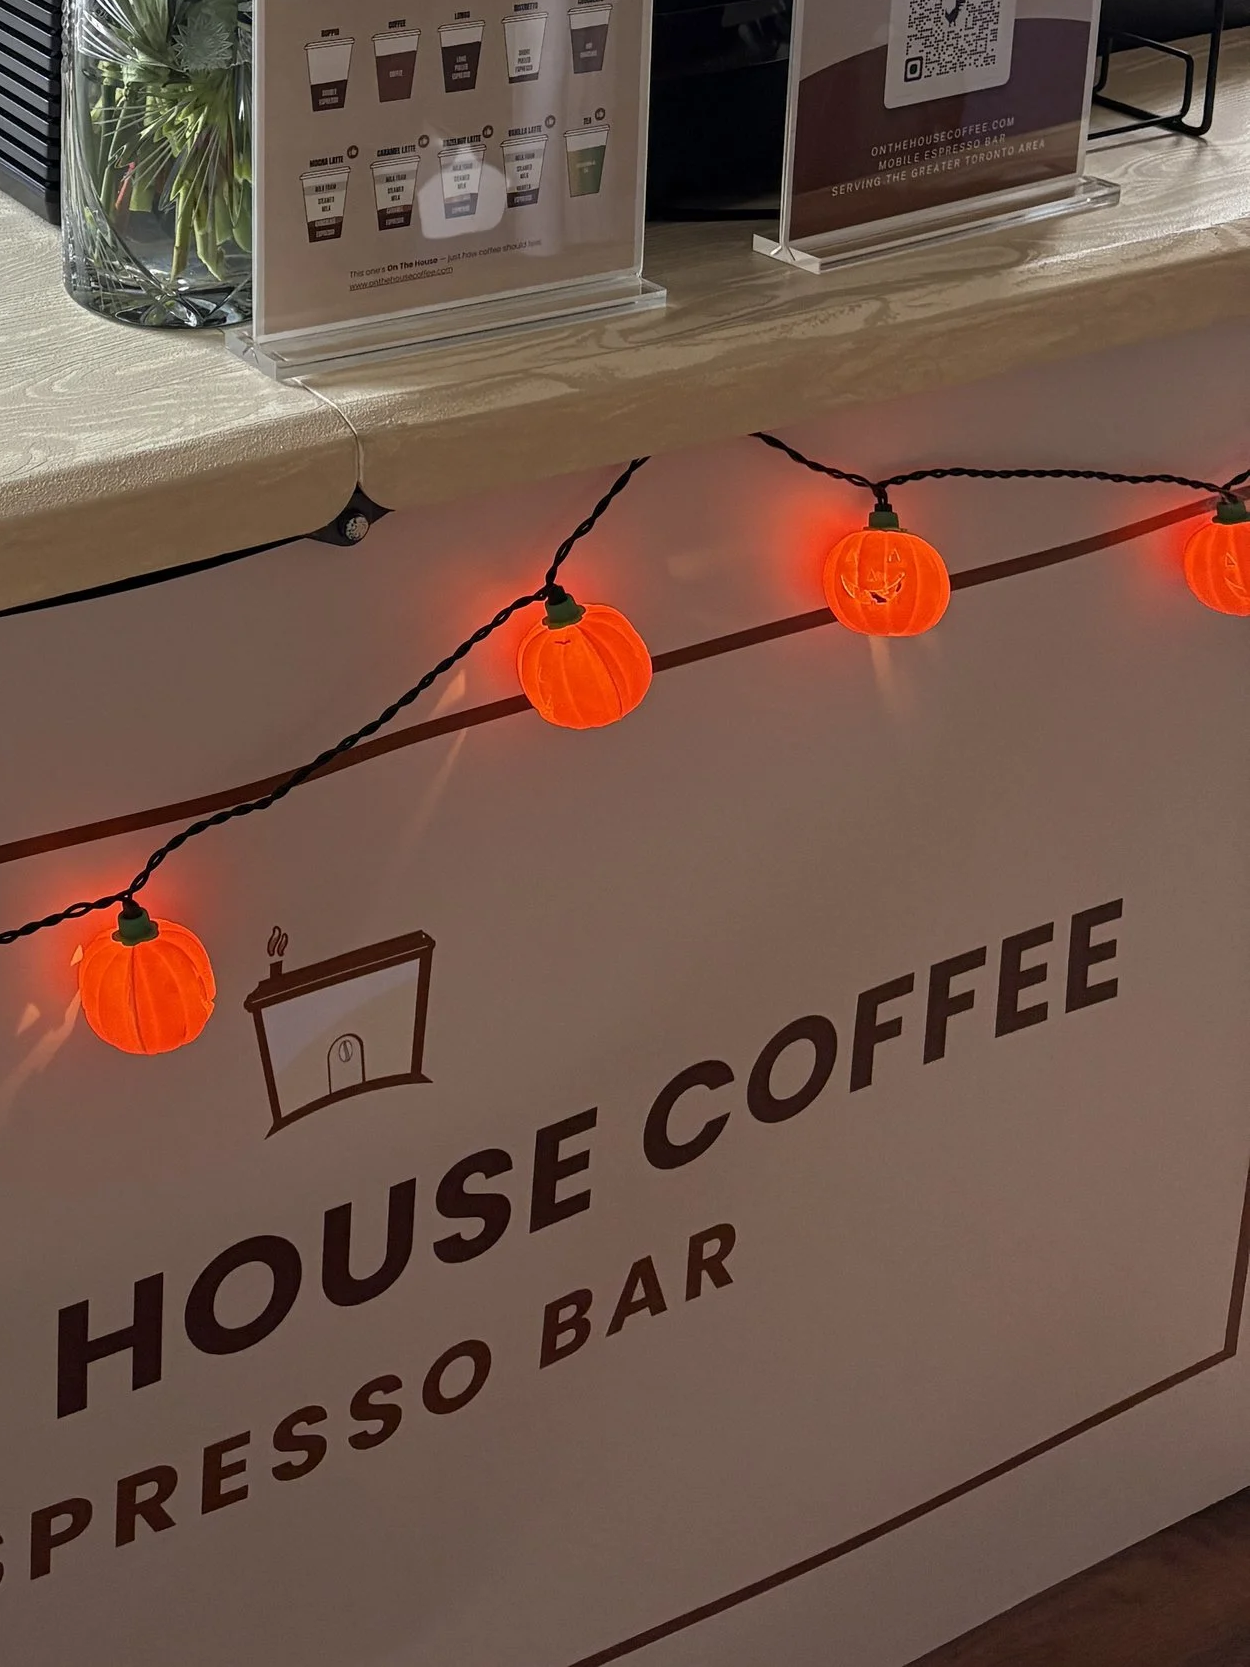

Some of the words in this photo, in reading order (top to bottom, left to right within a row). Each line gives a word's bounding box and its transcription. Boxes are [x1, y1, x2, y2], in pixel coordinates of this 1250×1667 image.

[871, 116, 1015, 157] ONTHEHOUSECOFFEE.COM
[878, 152, 920, 171] MOBILE
[924, 139, 981, 161] ESPRESSO
[984, 133, 1006, 147] BAR
[329, 155, 344, 165] LATTE
[831, 176, 881, 197] SERVING
[886, 170, 907, 183] THE
[911, 158, 961, 178] GREATER
[965, 146, 1015, 167] TORONTO
[1018, 138, 1045, 154] AREA
[387, 264, 399, 272] On
[400, 261, 414, 270] The
[414, 258, 439, 267] House
[57, 1106, 598, 1419] HOUSE
[643, 897, 1123, 1170] COFFEE
[539, 1222, 736, 1369] BAR
